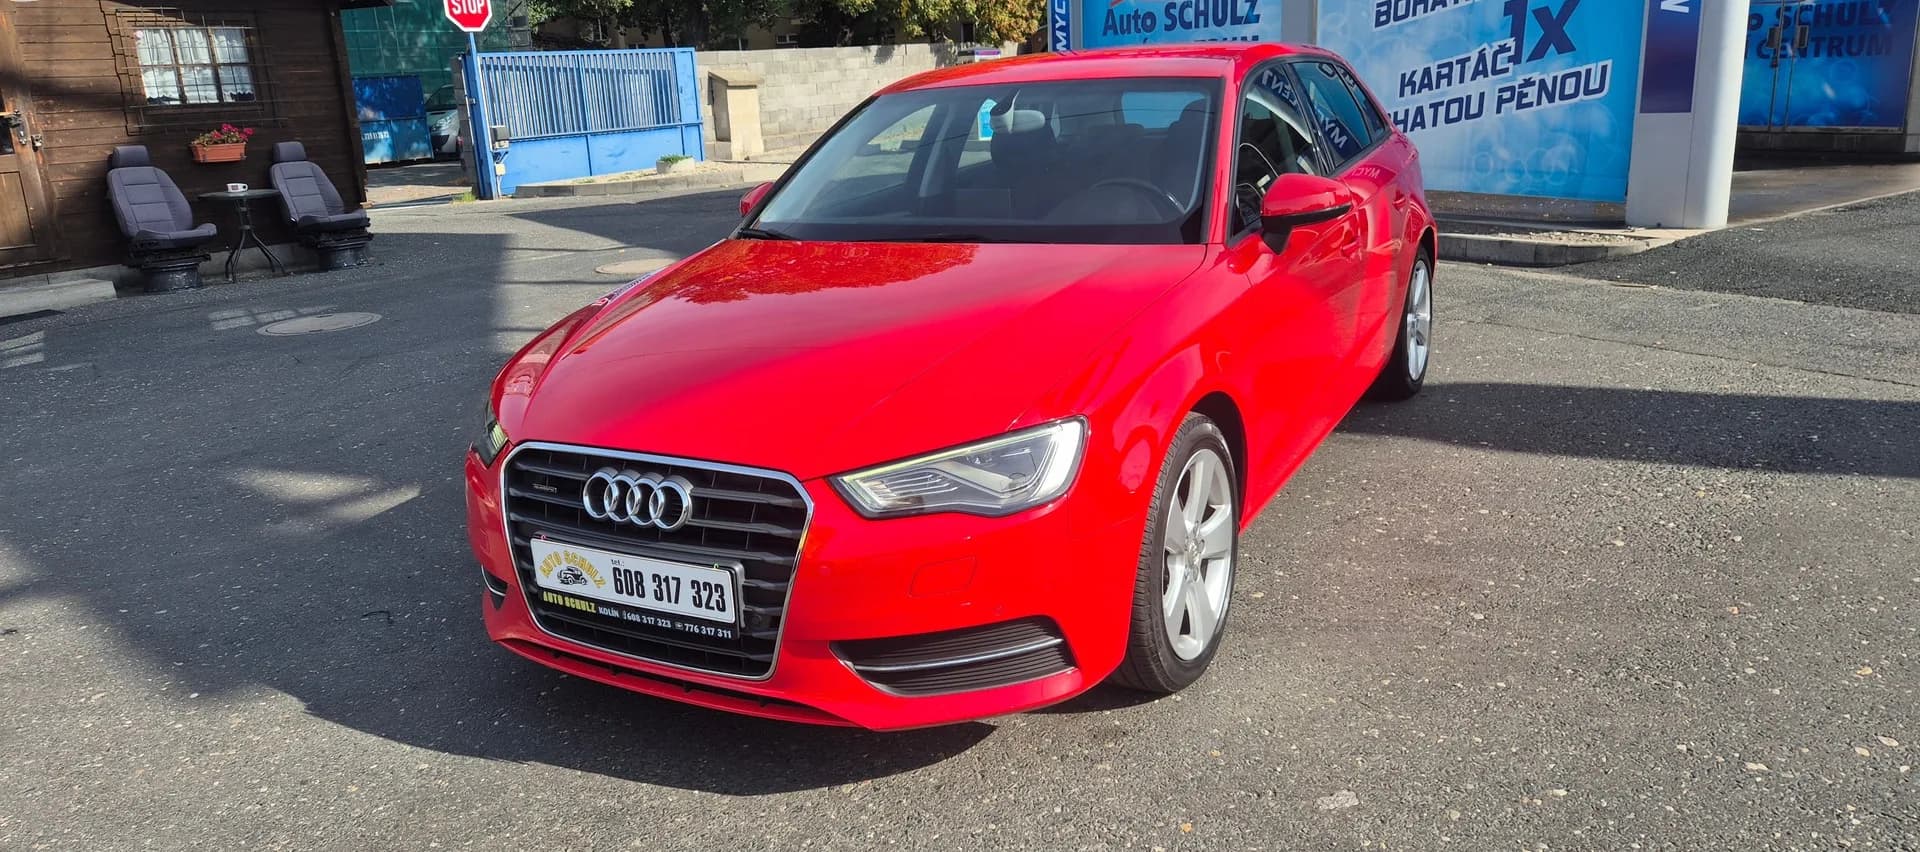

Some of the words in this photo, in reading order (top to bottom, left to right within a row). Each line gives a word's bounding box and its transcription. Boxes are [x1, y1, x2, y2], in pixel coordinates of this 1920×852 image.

[1103, 9, 1156, 36] Auto
[1164, 0, 1260, 31] SCHULZ
[1399, 42, 1512, 98] KARTÁČ
[1496, 64, 1608, 114] PĚNOU
[613, 566, 645, 598] 608
[652, 573, 681, 605] 317
[691, 579, 726, 612] 323
[543, 591, 564, 606] AUTO
[564, 595, 597, 613] SCHULZ
[626, 613, 640, 622] 608
[641, 615, 655, 625] 317
[657, 618, 671, 628] 323
[684, 623, 699, 633] 776
[701, 626, 715, 636] 317
[717, 629, 732, 639] 311
